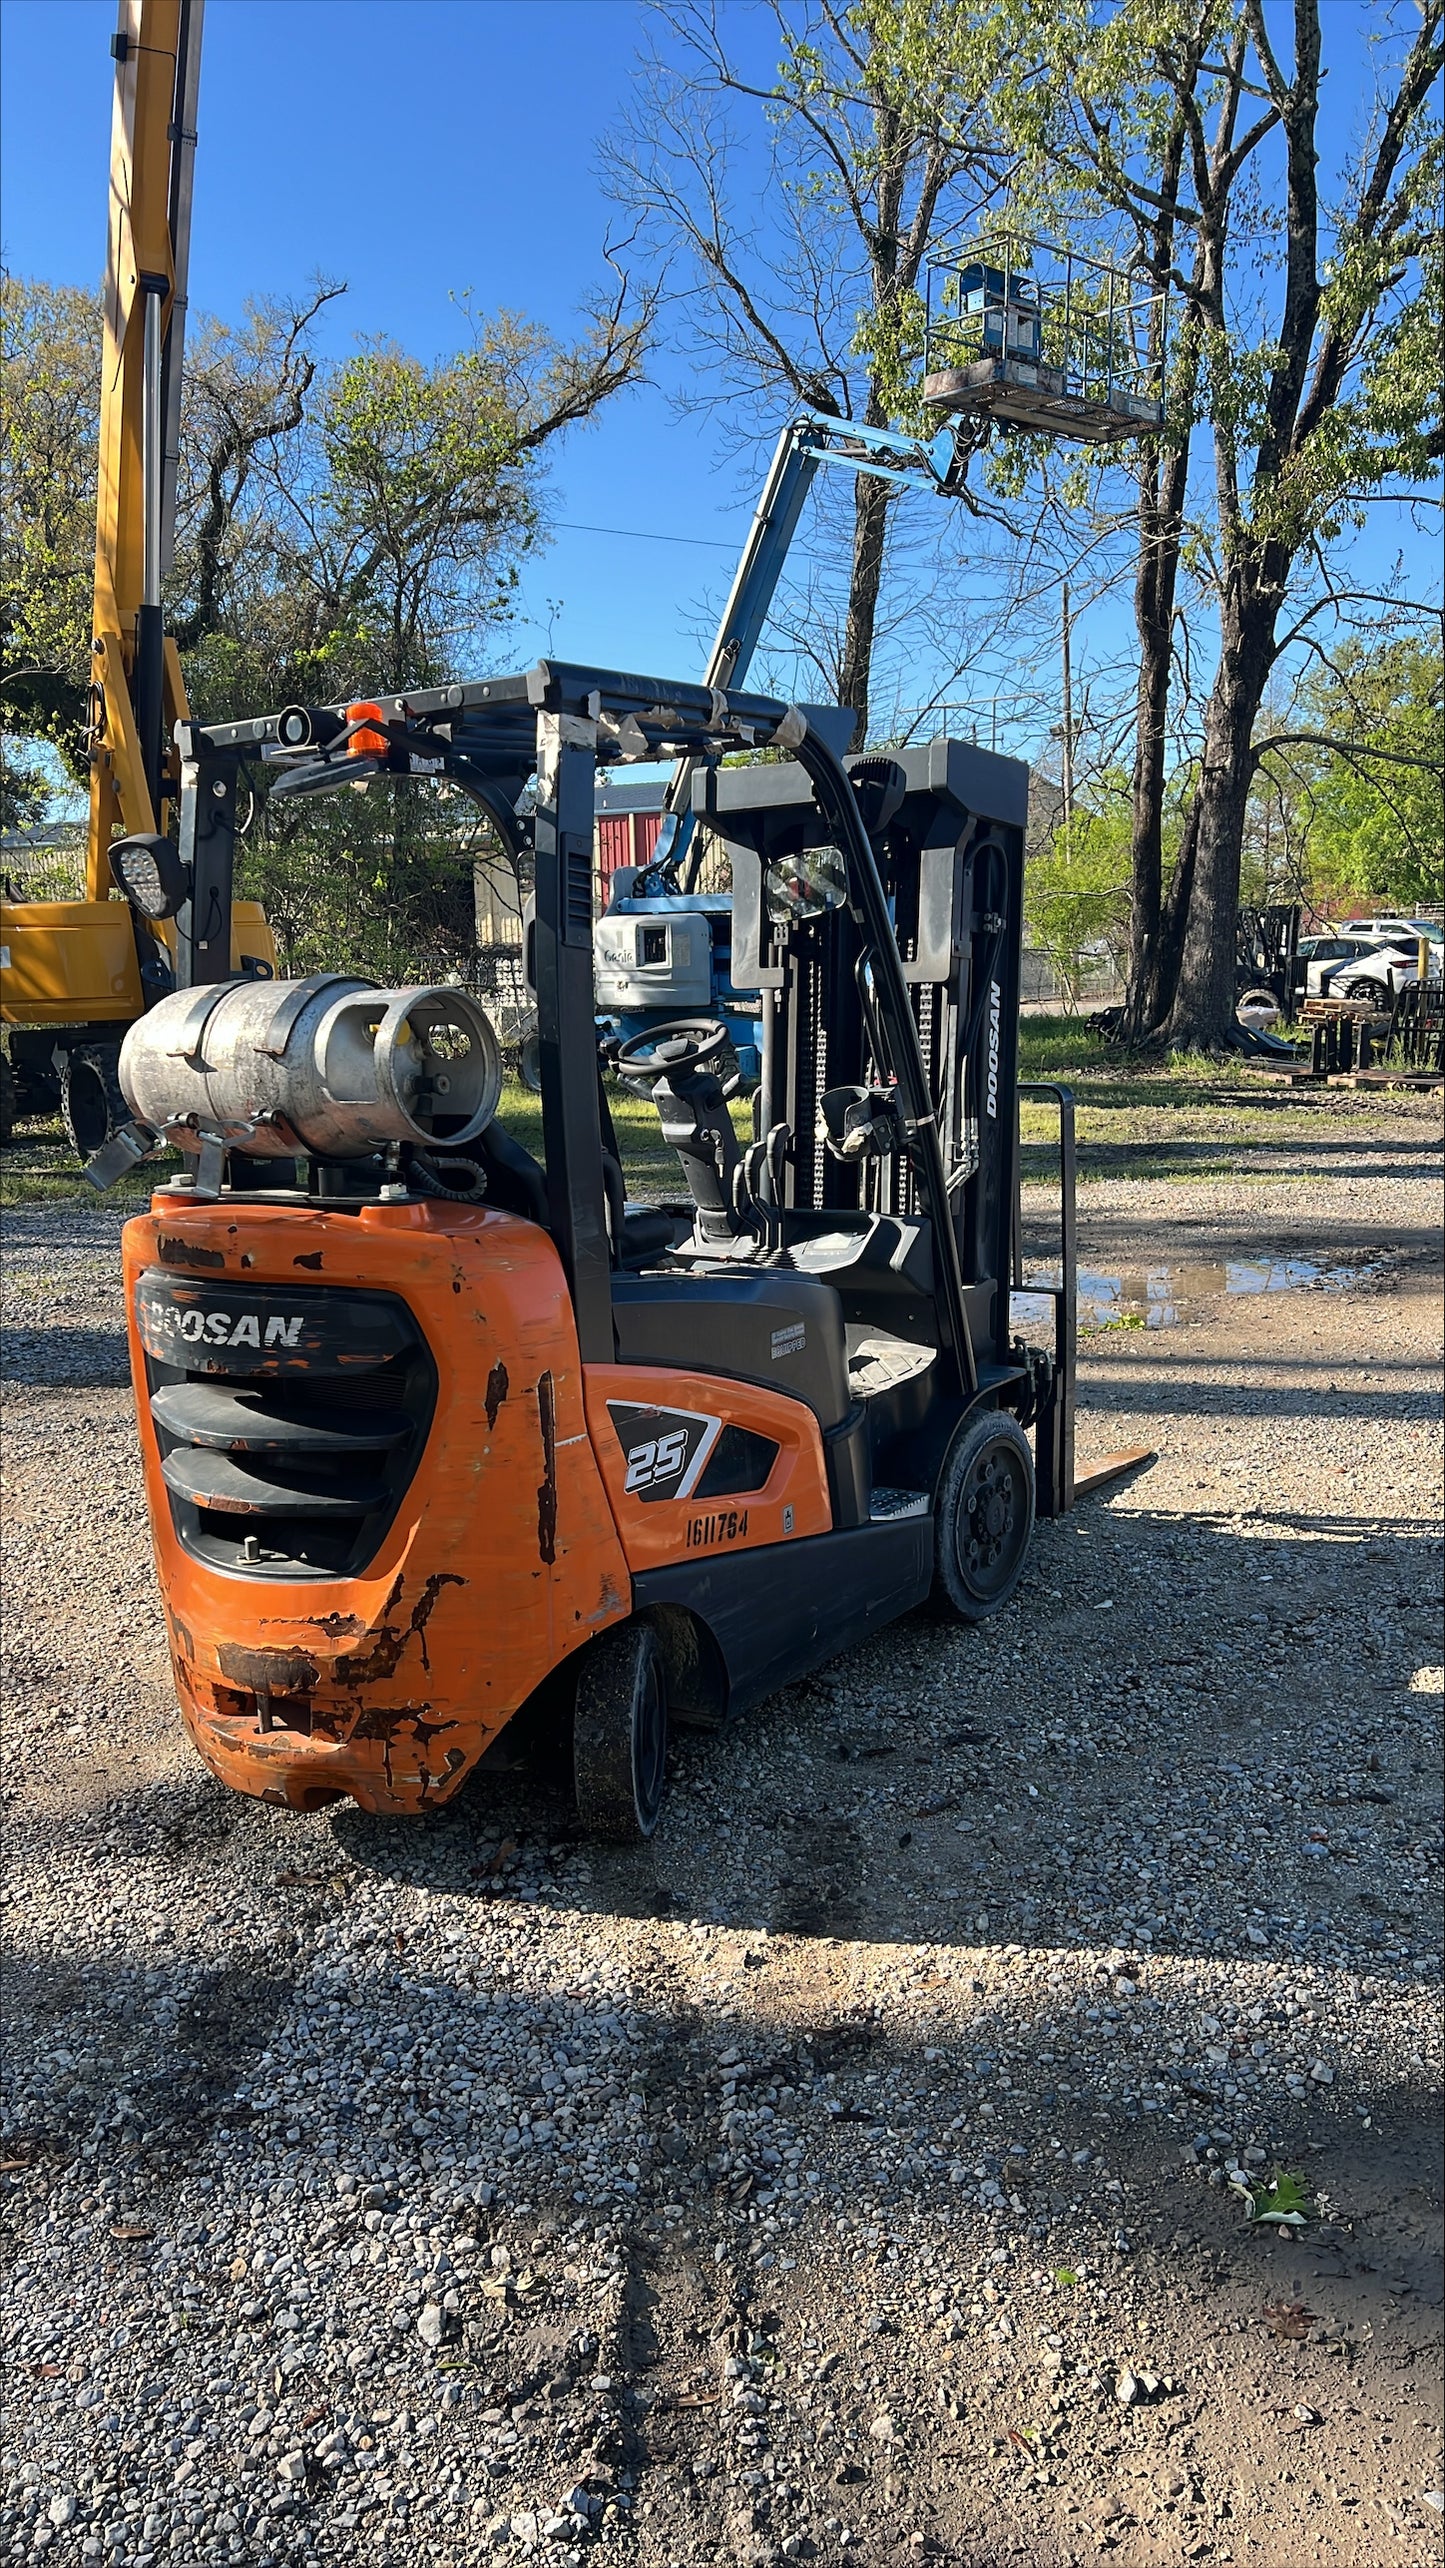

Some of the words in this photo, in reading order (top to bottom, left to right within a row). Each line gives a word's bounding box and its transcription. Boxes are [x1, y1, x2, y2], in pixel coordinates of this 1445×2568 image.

[986, 980, 1001, 1119] DOOSAN
[624, 1429, 689, 1495] 25
[686, 1510, 748, 1548] 1611764
